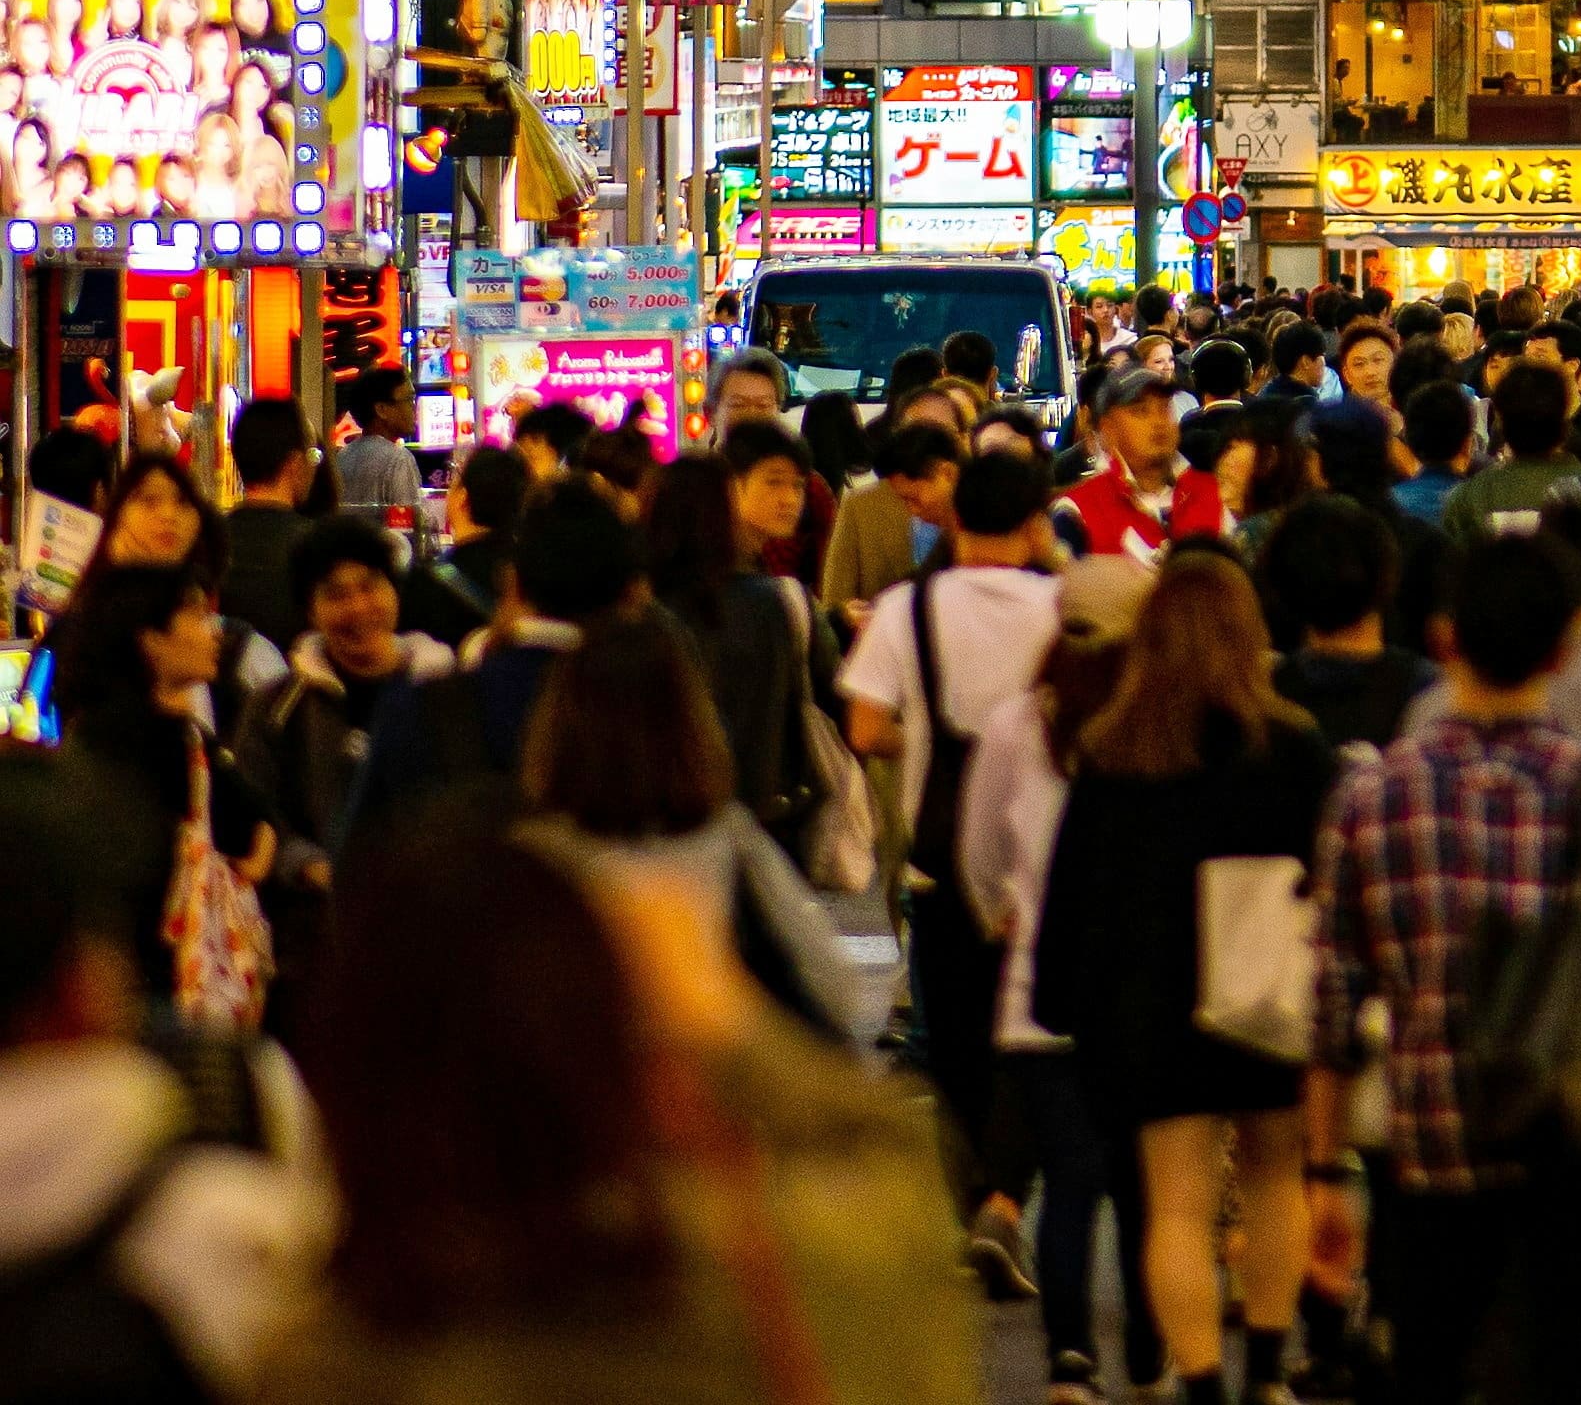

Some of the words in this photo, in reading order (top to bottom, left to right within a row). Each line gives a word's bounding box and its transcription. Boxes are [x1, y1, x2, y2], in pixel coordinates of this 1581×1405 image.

[888, 107, 968, 123] 地域最大!!
[895, 134, 1027, 179] ゲーム
[475, 282, 507, 294] VISA
